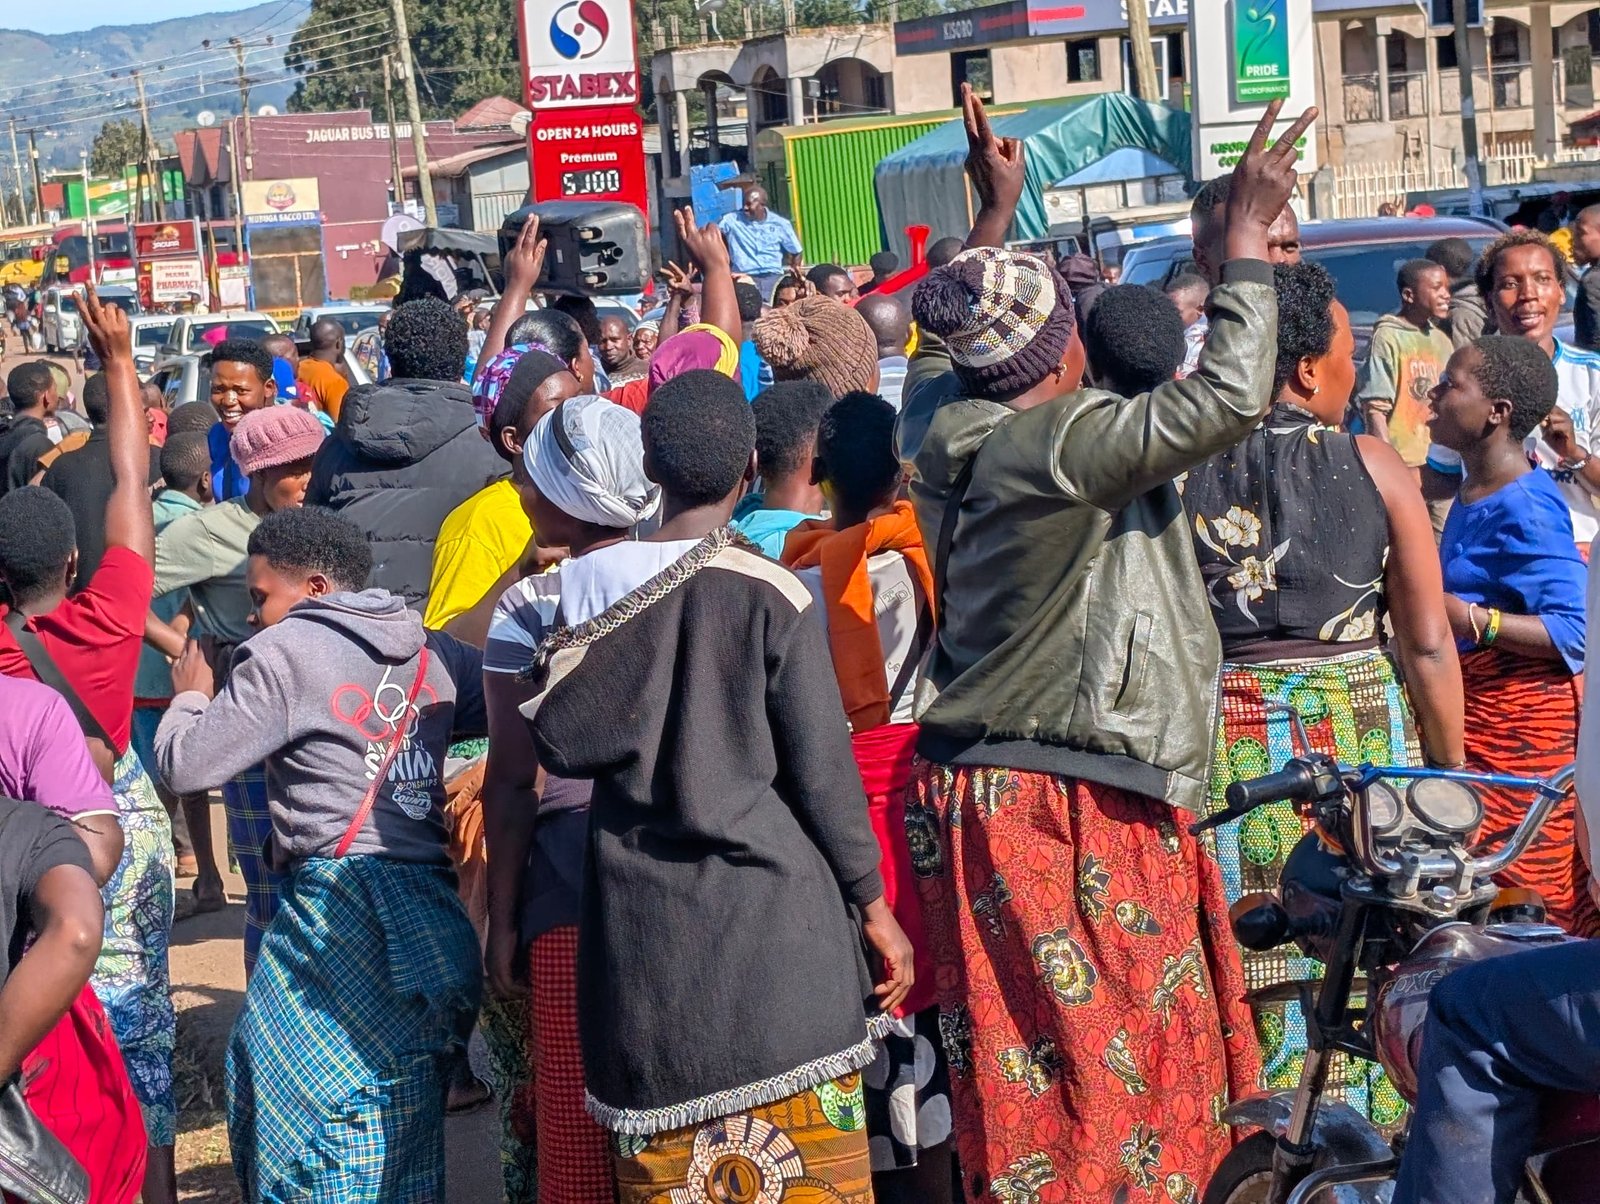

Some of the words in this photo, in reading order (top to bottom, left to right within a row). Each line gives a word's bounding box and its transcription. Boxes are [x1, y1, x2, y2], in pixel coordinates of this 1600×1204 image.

[943, 19, 973, 40] KISORO
[1246, 64, 1279, 77] PRIDE
[530, 71, 636, 102] STABEX
[1240, 85, 1289, 95] MICROFINANCE
[306, 126, 350, 143] JAGUAR
[351, 126, 374, 140] BUS
[536, 127, 572, 141] OPEN
[573, 126, 590, 139] 24
[591, 122, 638, 138] HOURS
[560, 152, 618, 164] Premium
[279, 213, 302, 223] SACCO
